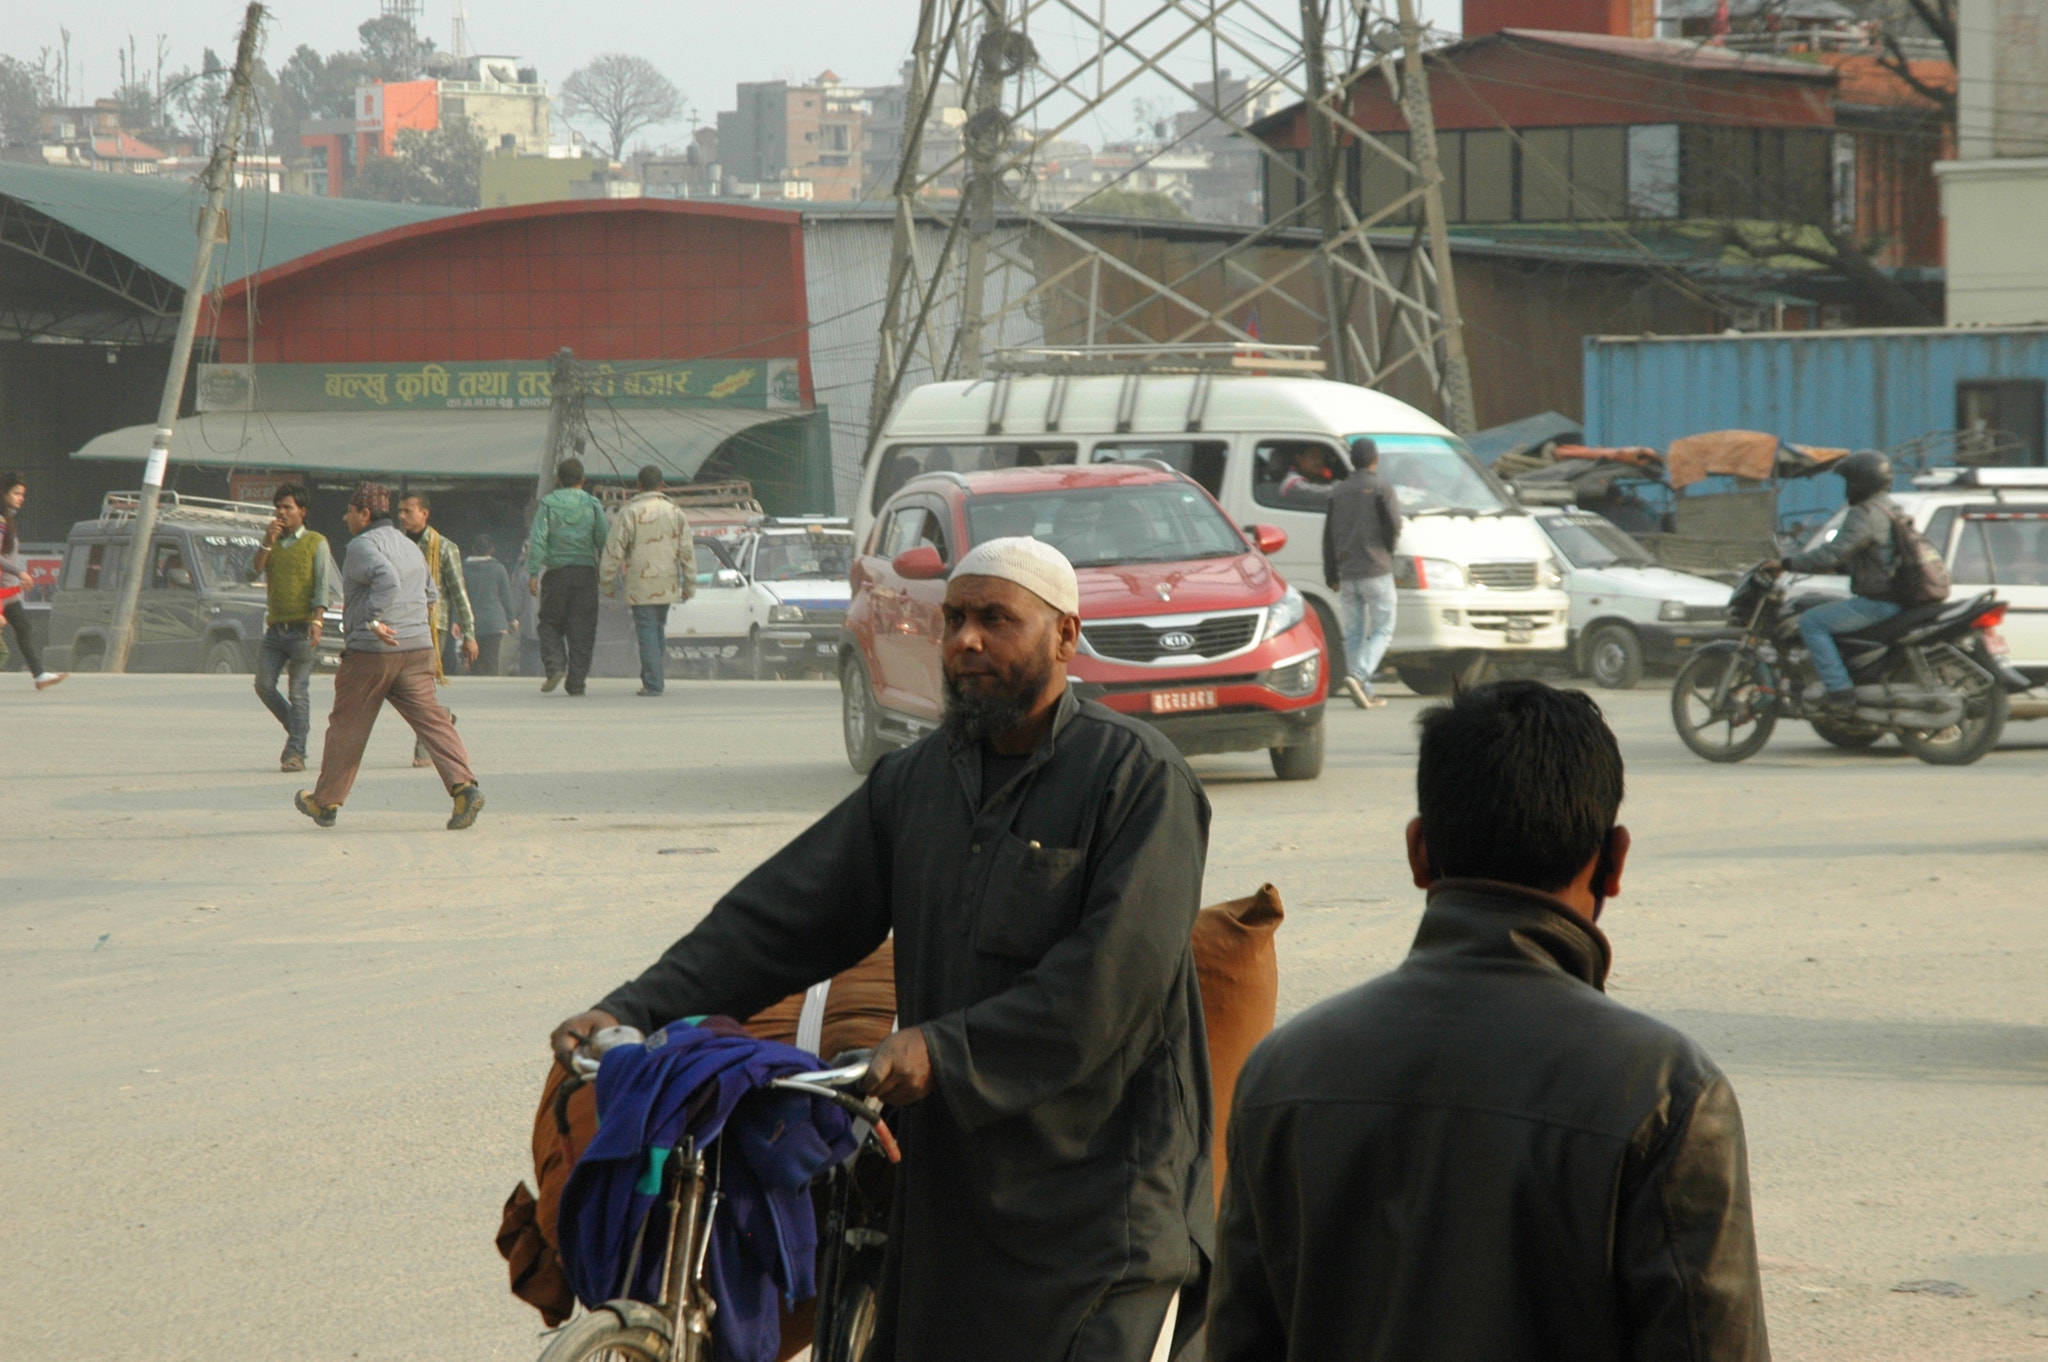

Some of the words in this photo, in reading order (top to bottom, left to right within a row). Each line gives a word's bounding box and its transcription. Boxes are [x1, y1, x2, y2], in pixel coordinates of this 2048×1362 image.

[324, 372, 389, 405] बल्खु
[395, 364, 450, 402] कृषि
[457, 370, 511, 397] तथा
[1165, 635, 1189, 647] KIA
